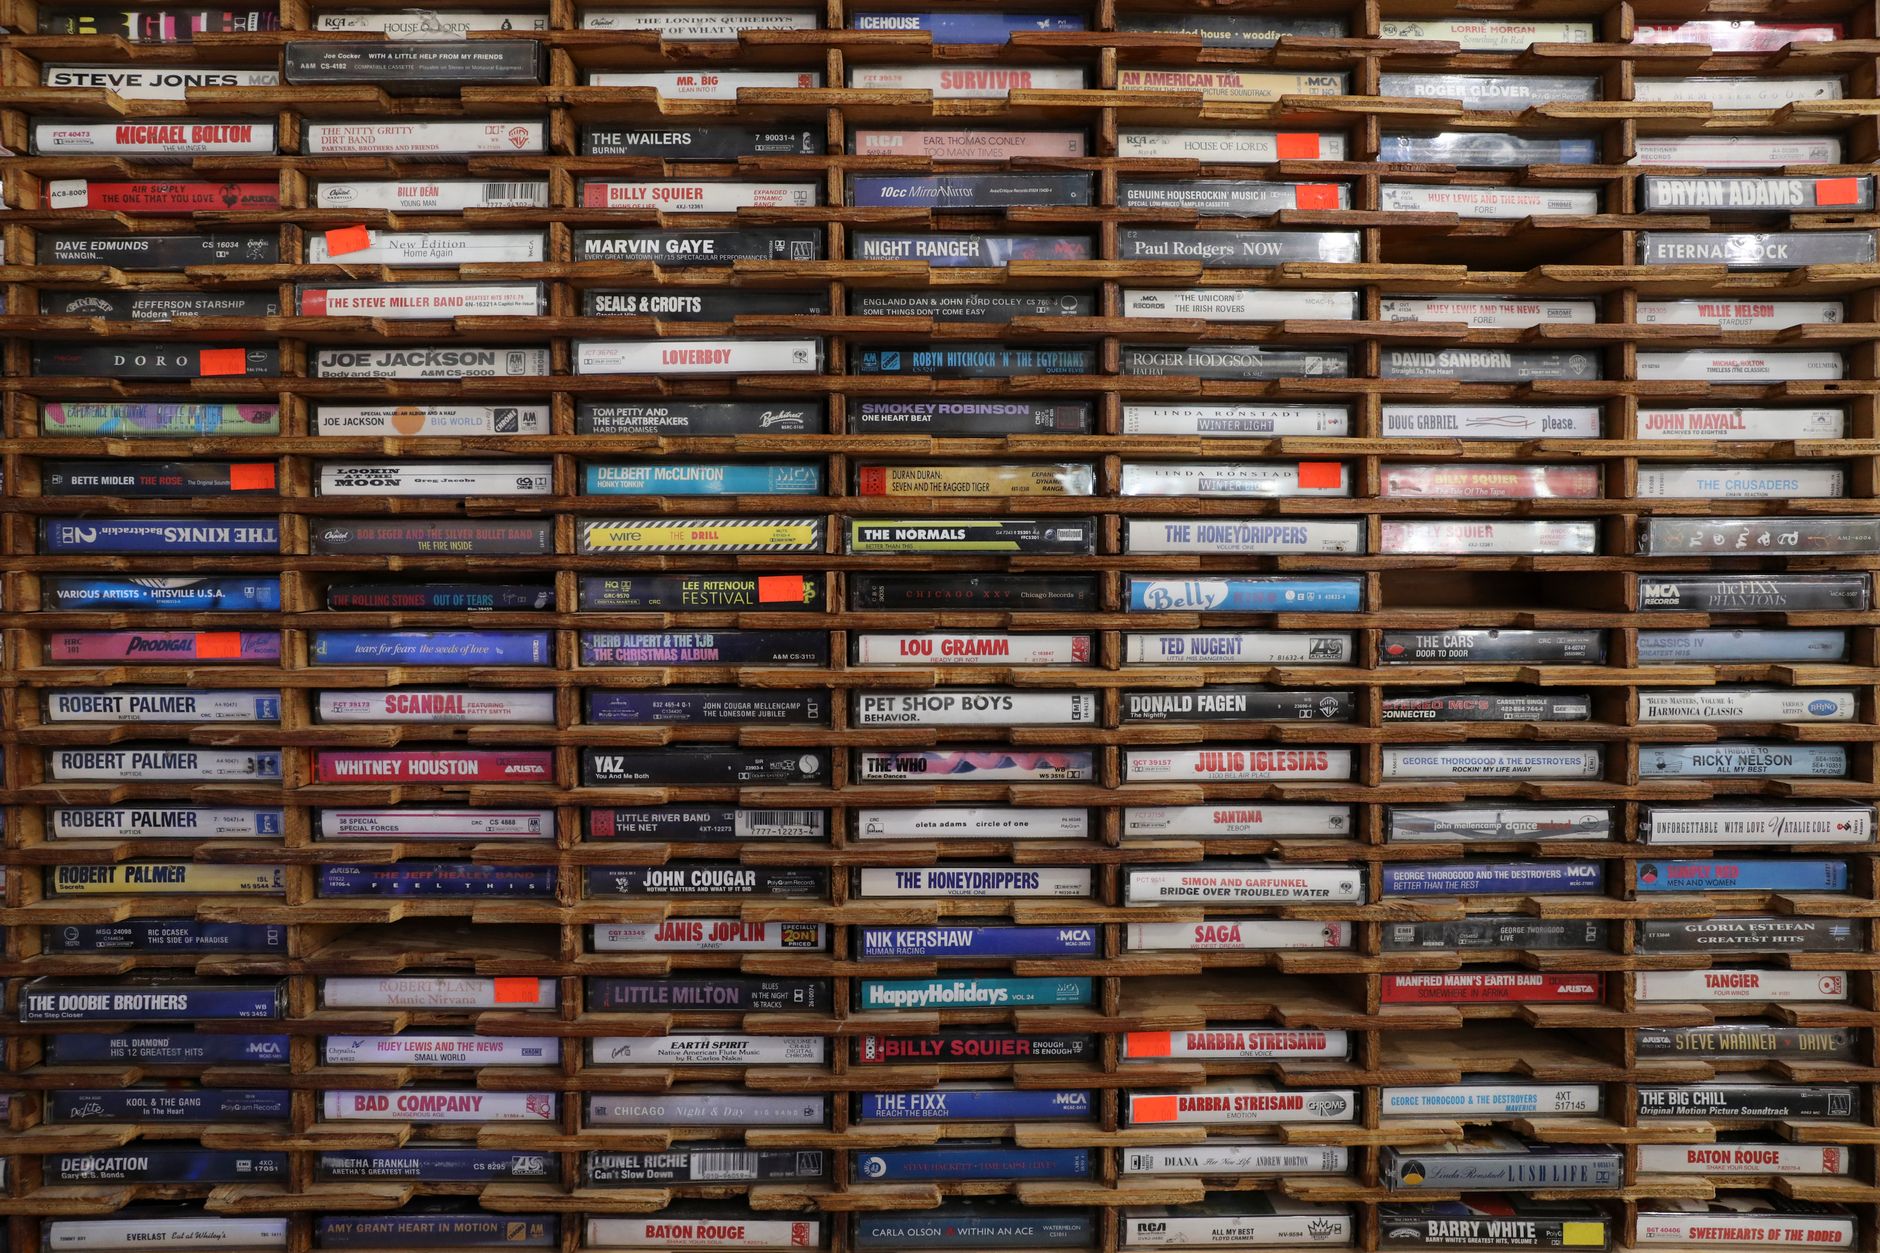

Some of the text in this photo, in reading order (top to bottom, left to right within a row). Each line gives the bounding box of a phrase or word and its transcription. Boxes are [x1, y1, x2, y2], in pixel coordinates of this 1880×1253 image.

[859, 16, 920, 30] ICEHOUSE
[54, 72, 238, 87] STEVE JONES
[115, 125, 253, 145] MICHAEL BOLTON
[592, 132, 692, 146] THE WAILERS
[592, 146, 628, 154] BURNIN'
[609, 187, 704, 201] BILLY SQUIER
[1127, 190, 1165, 201] GENUINE
[1168, 190, 1229, 201] HOUSEROCKIN'
[1231, 190, 1258, 201] MUSIC
[1657, 180, 1804, 206] BRYAN ADAMS
[585, 239, 715, 254] MARVIN GAYE
[1134, 241, 1283, 259] Paul Rodgers NOW
[1174, 304, 1245, 314] THE IRISH ROVERS
[1697, 304, 1775, 318] WILLIE NELSON
[321, 351, 496, 368] JOE JACKSON
[662, 348, 732, 365] LOVERBOY
[592, 408, 668, 416] TOM PETTY AND
[592, 417, 689, 425] THE HEARTBREAKERS
[1387, 415, 1577, 432] DOUG GABRIEL please.
[1645, 414, 1746, 431] JOHN MAYALL
[71, 475, 183, 487] BETTE MIDLER THE ROSE
[1696, 479, 1799, 490] THE CRUSADERS
[164, 528, 277, 543] THE KINKS
[864, 528, 966, 541] THE NORMALS
[1164, 525, 1308, 545] THE HONEYDRIPPERS
[418, 541, 473, 551] THE FIRE INSIDE
[682, 591, 754, 605] FESTIVAL
[1416, 635, 1474, 648] THE CARS
[1416, 649, 1469, 658] DOOR TO DOOR
[59, 696, 196, 712] ROBERT PALMER
[865, 696, 1013, 712] PET SHOP BOYS
[1130, 695, 1247, 714] DONALD FAGEN
[864, 713, 920, 723] BEHAVIOR.
[335, 759, 479, 776] WHITNEY HOUSTON
[594, 757, 624, 773] YAZ
[1692, 755, 1793, 766] RICKY NELSON
[616, 814, 711, 822] LITTLE RIVER BAND
[1213, 810, 1263, 824] SANTANA
[1160, 887, 1329, 897] BRIDGE OVER TROUBLED WATER
[147, 928, 189, 936] RIC OCASEK
[1194, 925, 1241, 943] SAGA
[1685, 923, 1816, 932] GLORIA ESTEFAN
[1396, 976, 1543, 987] MANFRED MANN'S EARTH BAND
[28, 995, 188, 1010] THE DOOBIE BROTHERS
[670, 1041, 750, 1049] EARTH SPIRIT
[414, 1053, 466, 1062] SMALL WORLD
[354, 1095, 483, 1113] BAD COMPANY
[875, 1094, 946, 1110] THE FIXX
[1179, 1095, 1304, 1112] BARBRA STREISAND
[1640, 1092, 1727, 1105] THE BIG CHILL
[1226, 1111, 1258, 1119] EMOTION
[1640, 1106, 1789, 1116] Original Motion Picture Soundtrack
[61, 1157, 148, 1172] DEDICATION
[1428, 1221, 1536, 1238] BARRY WHITE
[1689, 1227, 1842, 1242] SWEETHEARTS OF THE RODEO
